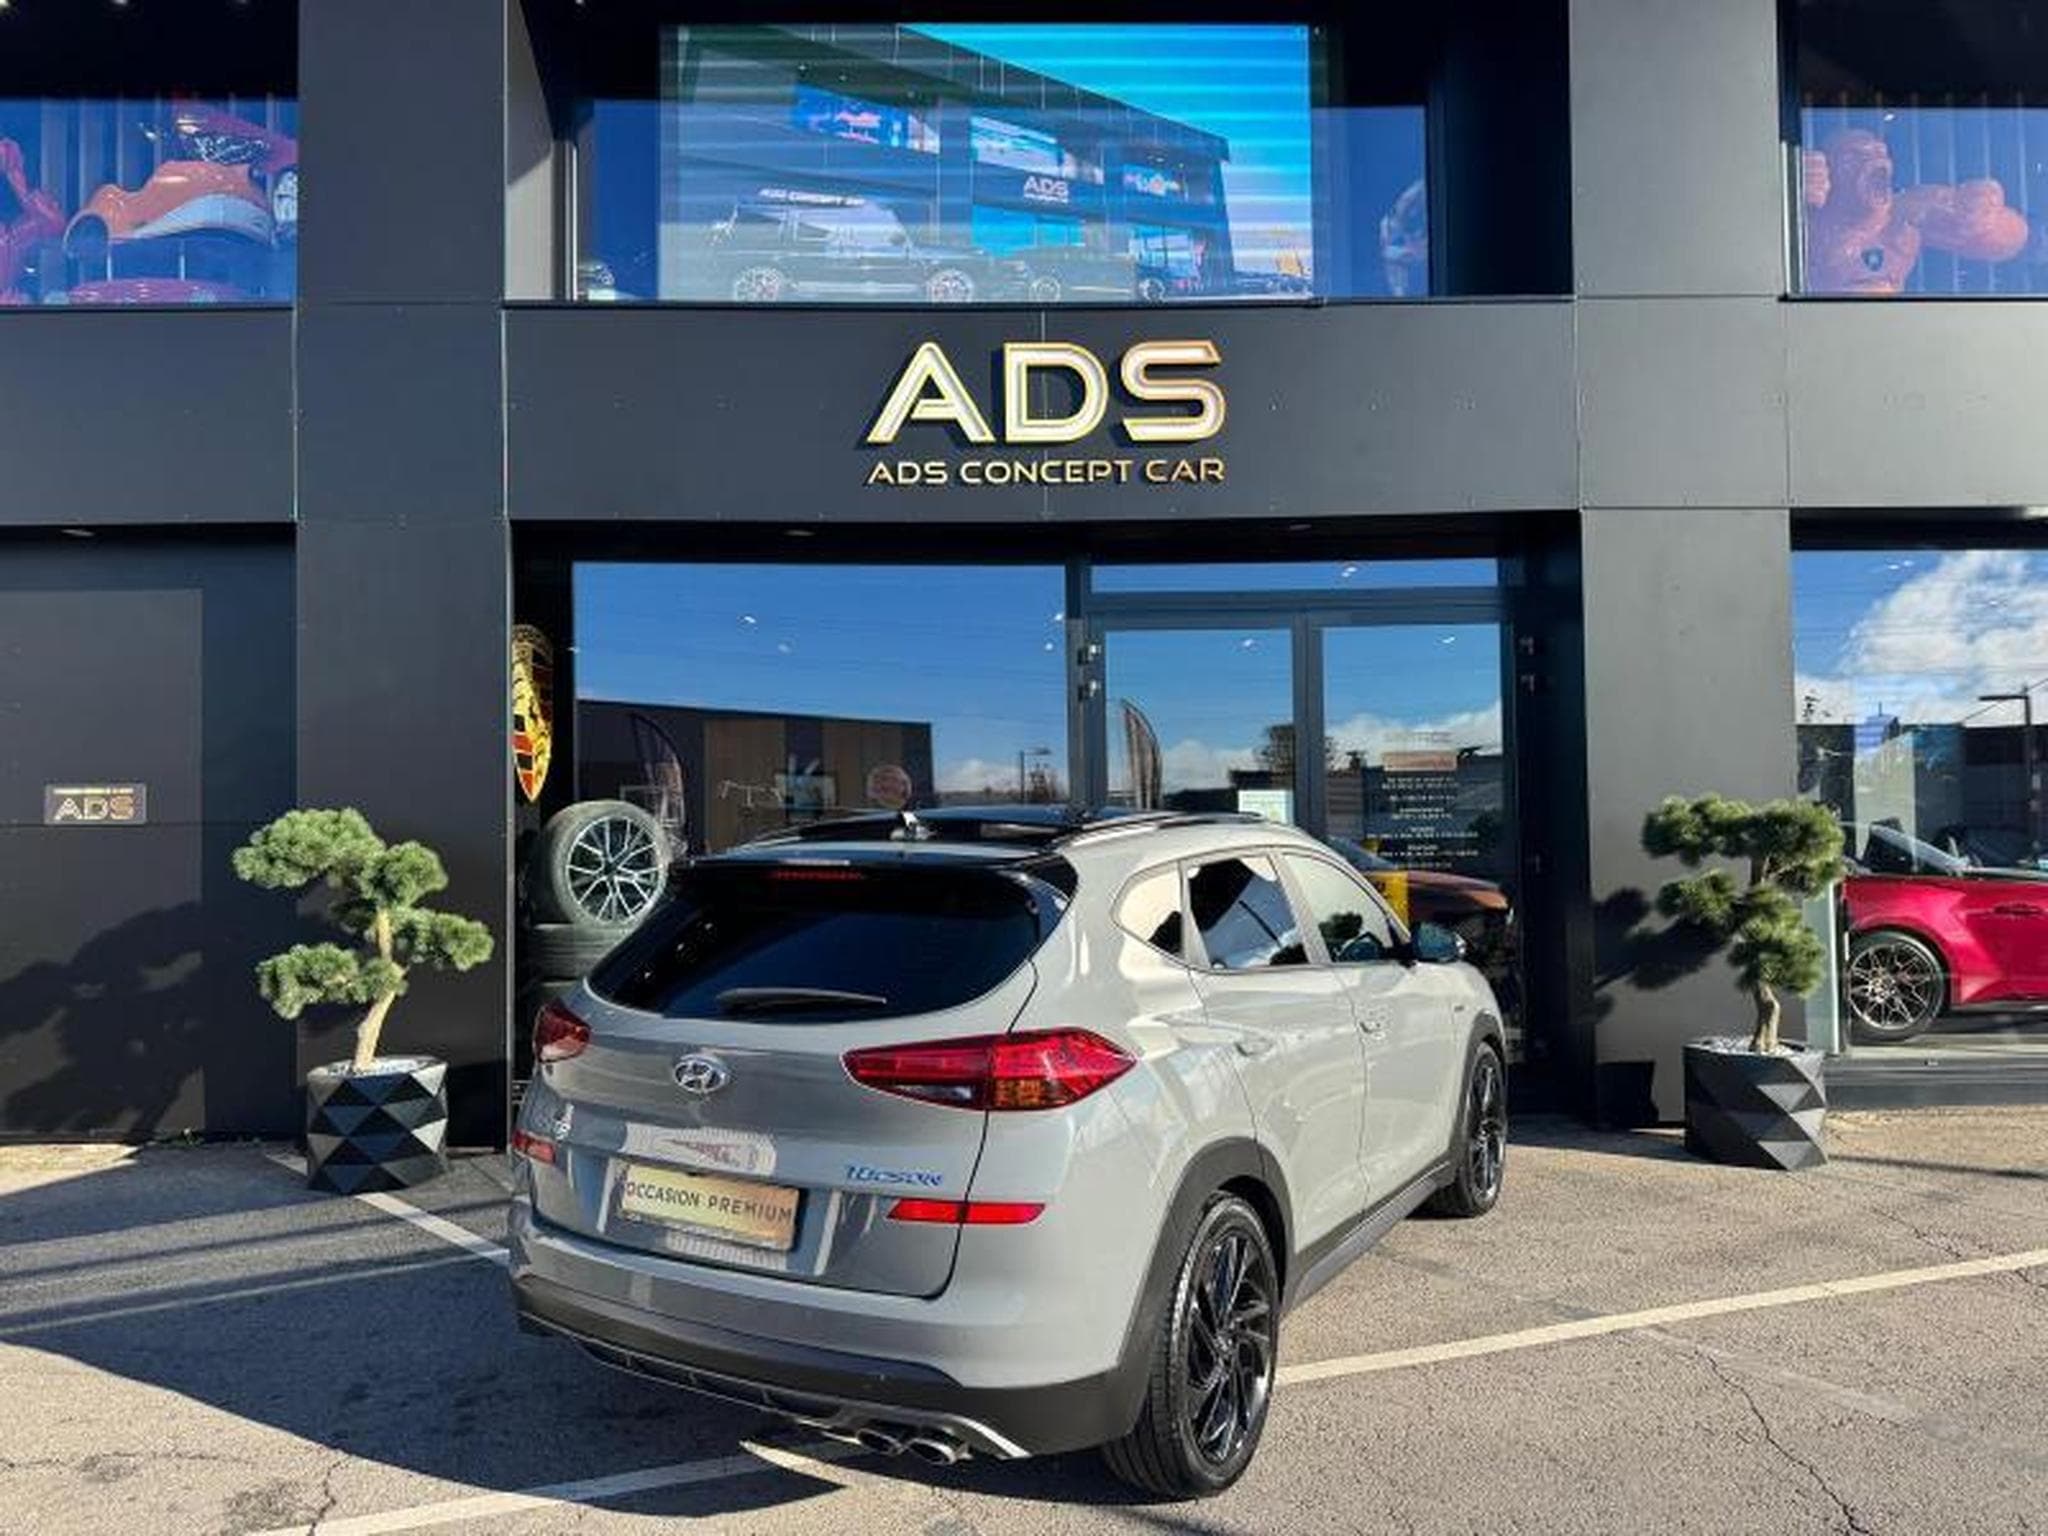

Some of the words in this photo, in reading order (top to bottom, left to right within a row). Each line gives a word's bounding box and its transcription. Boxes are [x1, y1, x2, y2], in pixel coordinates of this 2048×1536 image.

[866, 340, 1226, 443] ADS
[867, 461, 948, 484] ADS
[959, 461, 1133, 484] CONCEPT
[1145, 459, 1225, 483] CAR
[53, 796, 135, 821] ADS
[625, 1181, 701, 1207] OCCASION
[707, 1195, 794, 1224] PREMIUM
